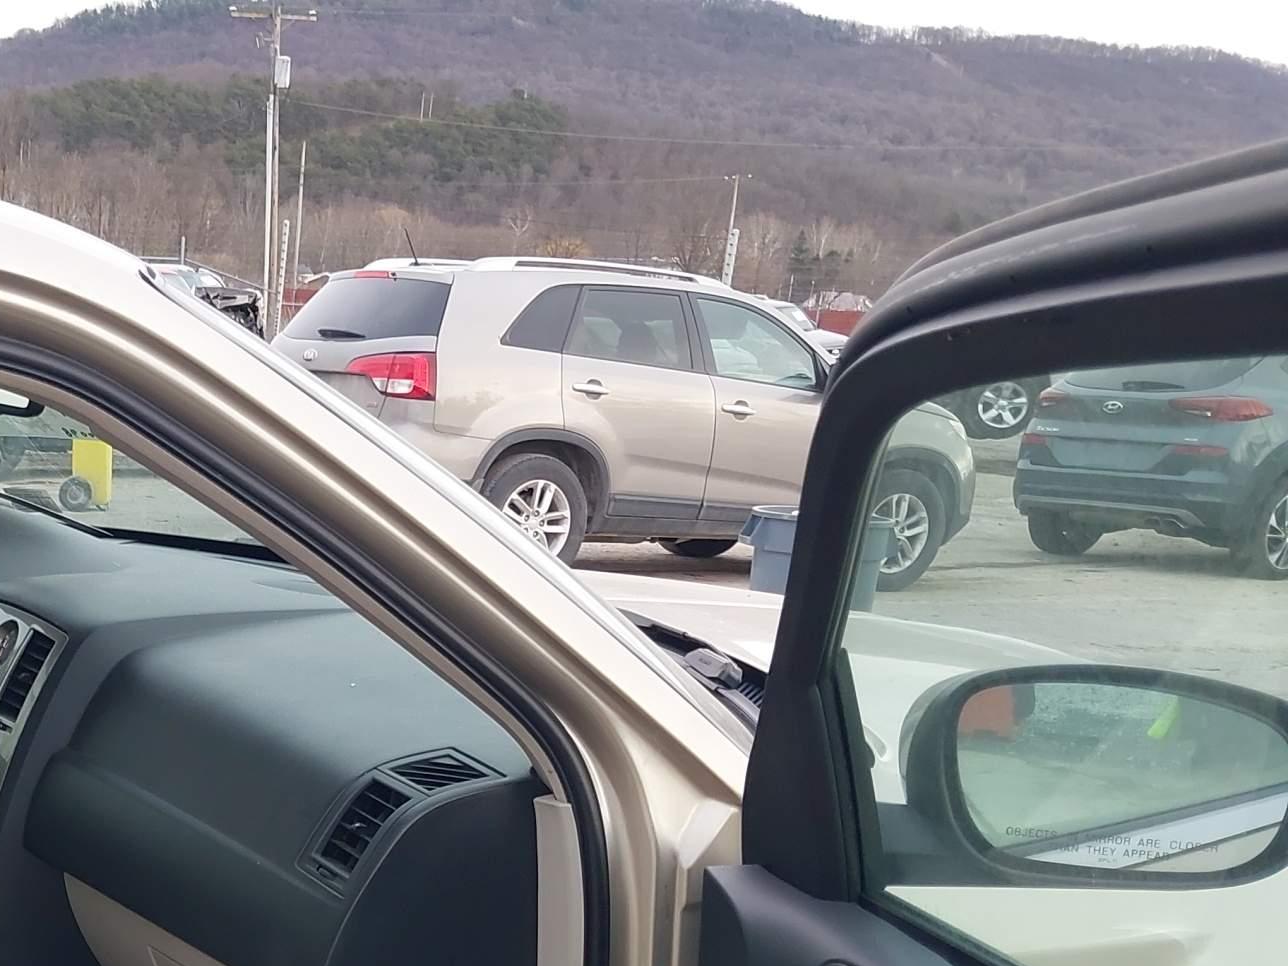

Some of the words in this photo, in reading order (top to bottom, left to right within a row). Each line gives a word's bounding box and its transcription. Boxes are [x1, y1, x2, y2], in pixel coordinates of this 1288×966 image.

[1005, 826, 1058, 839] OBJECTS
[1137, 837, 1161, 849] ARE
[1169, 839, 1219, 853] CLOSR
[1086, 845, 1117, 856] THEY
